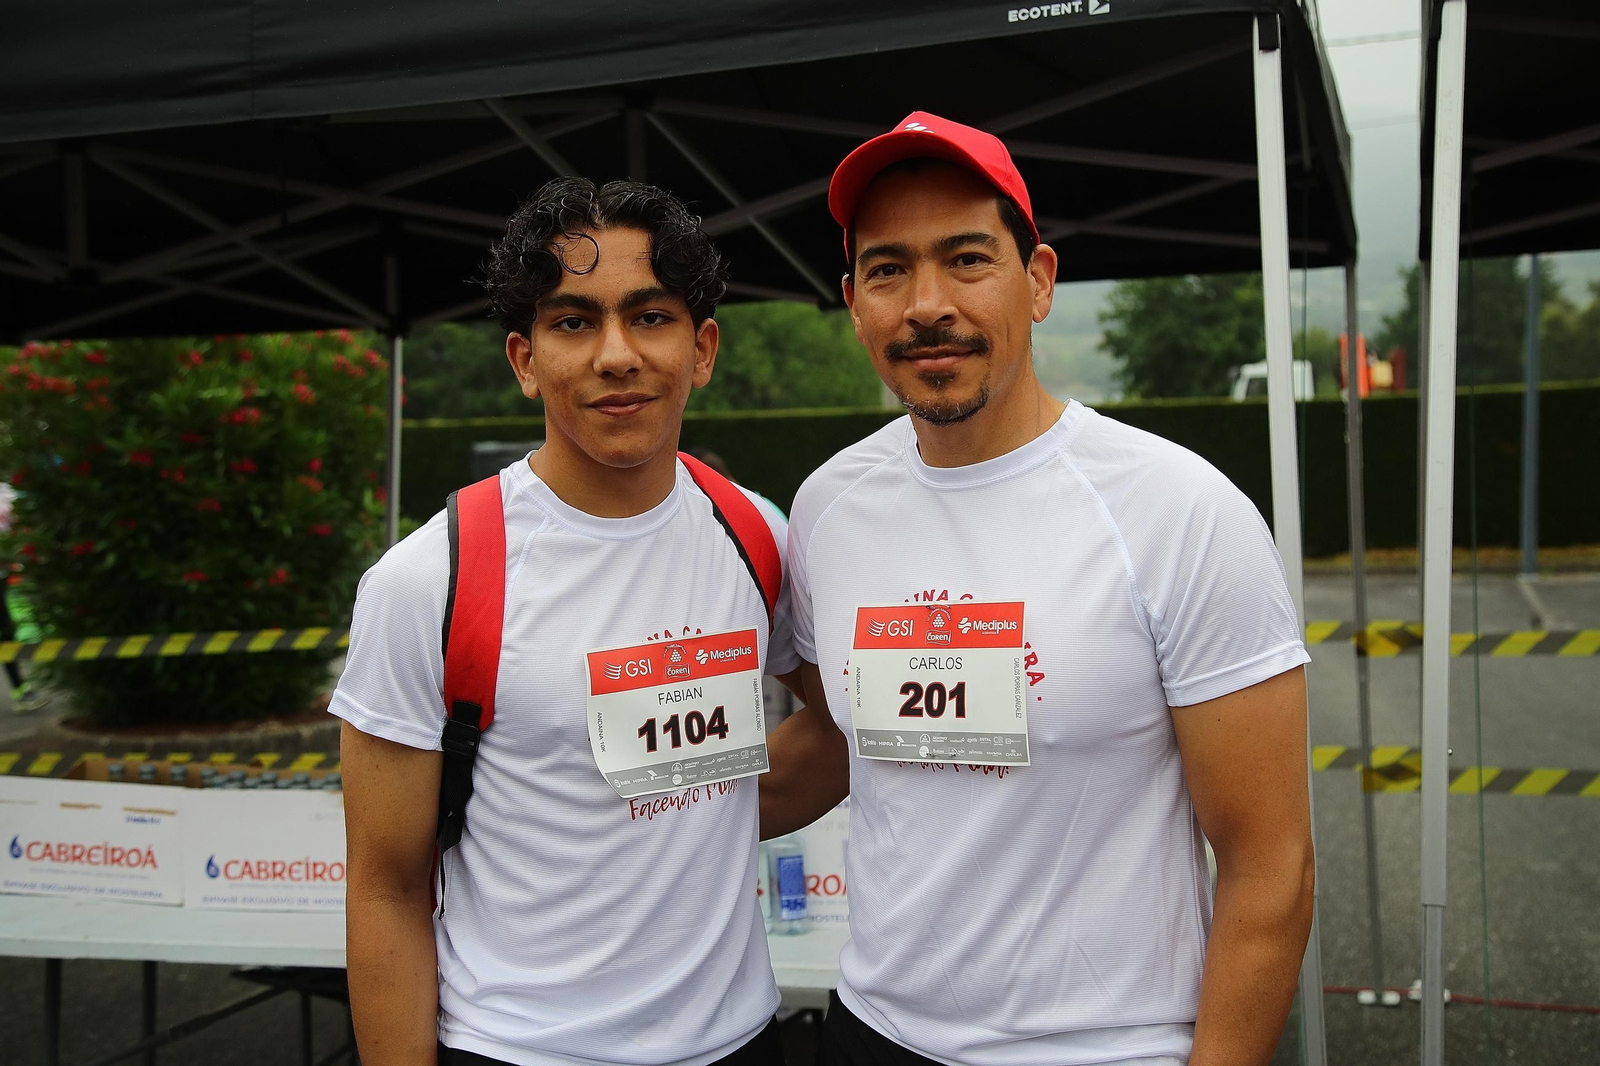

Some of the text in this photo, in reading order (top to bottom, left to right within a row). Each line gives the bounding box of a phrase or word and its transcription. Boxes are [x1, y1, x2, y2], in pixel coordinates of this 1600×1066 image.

[887, 619, 914, 637] GSI
[973, 620, 1017, 634] Mediplus
[710, 646, 752, 660] Mediplus
[625, 658, 653, 678] GSI
[909, 656, 963, 670] CARLOS
[658, 686, 703, 705] FABIAN
[898, 681, 967, 719] 201
[637, 705, 729, 753] 1104
[629, 787, 700, 820] Facendo
